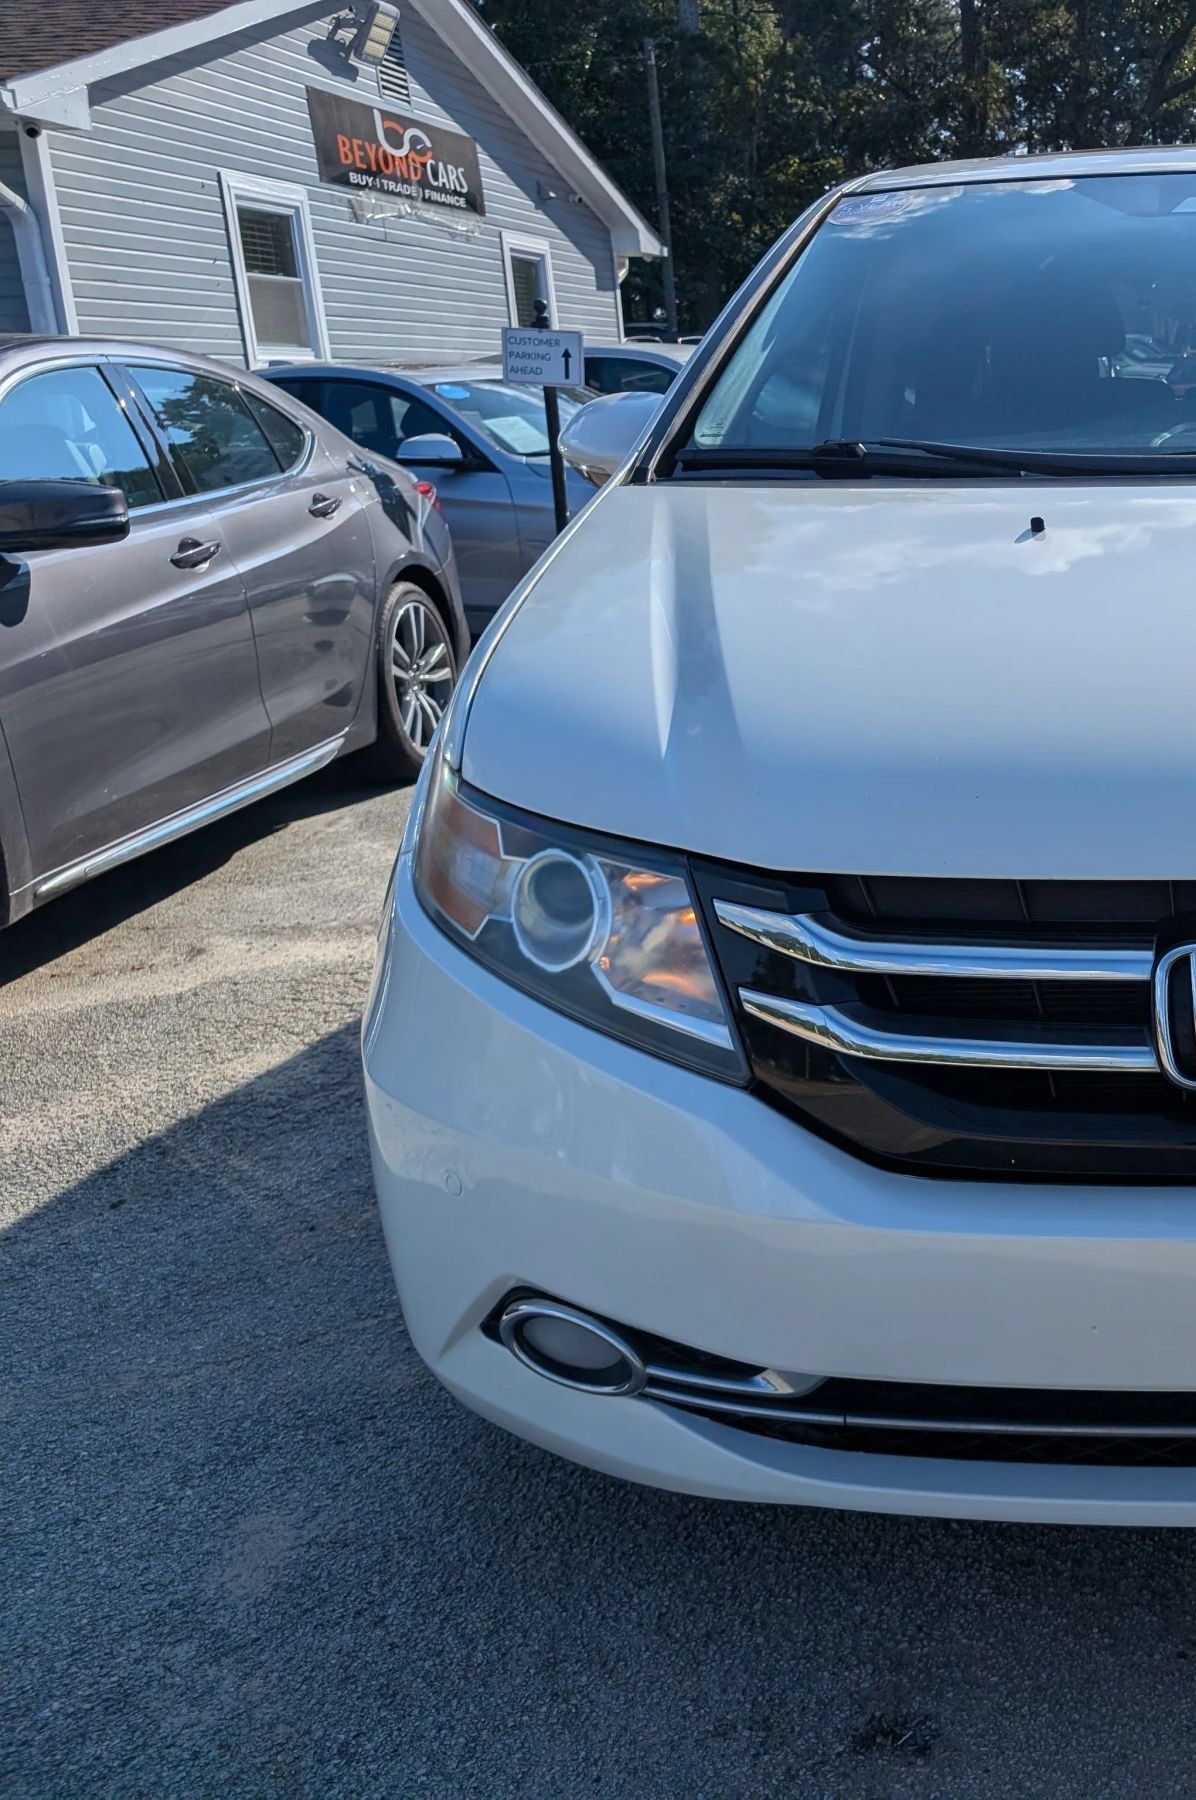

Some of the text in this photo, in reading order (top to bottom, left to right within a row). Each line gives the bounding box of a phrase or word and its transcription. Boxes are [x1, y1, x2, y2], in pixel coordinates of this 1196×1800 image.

[337, 134, 468, 194] BEYOND CARS
[348, 171, 468, 208] BUY TRADE FINANCE
[508, 336, 560, 347] CUSTOMER
[508, 350, 551, 361] PARKING
[509, 365, 543, 375] AHEAD
